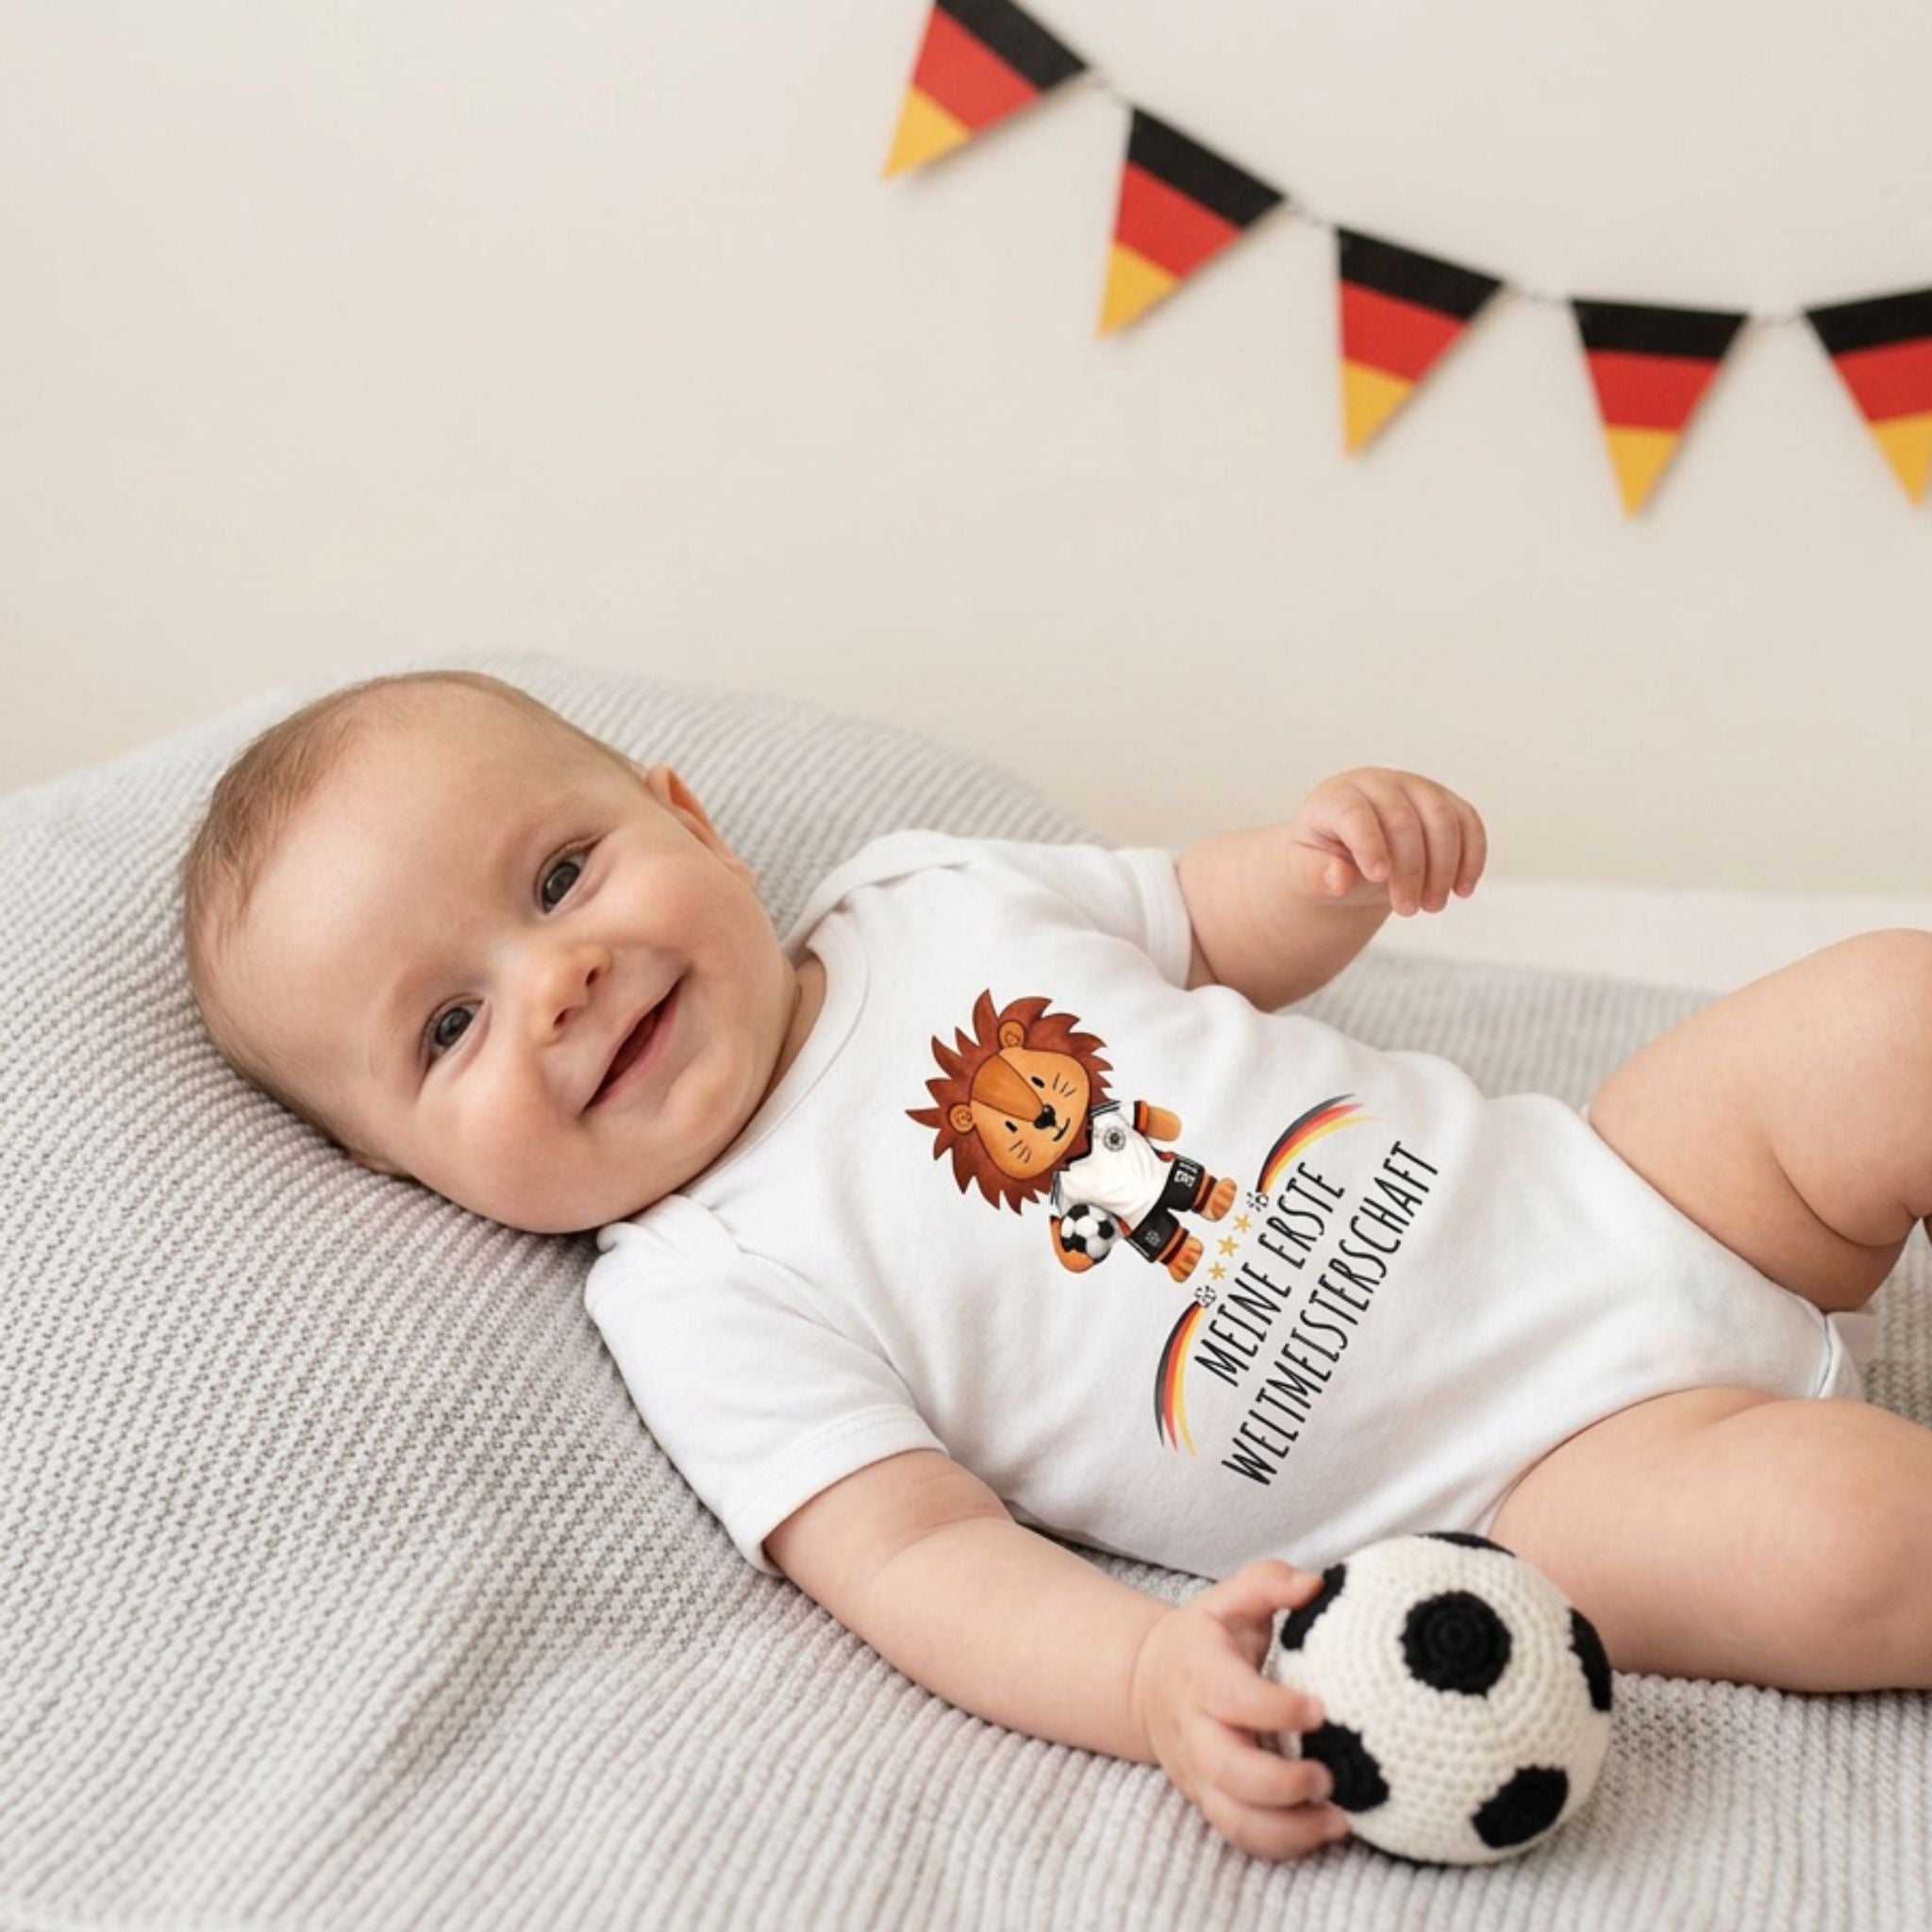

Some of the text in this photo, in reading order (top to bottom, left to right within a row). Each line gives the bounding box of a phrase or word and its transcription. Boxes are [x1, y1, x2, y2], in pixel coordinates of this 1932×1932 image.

[1193, 1161, 1345, 1388] MEINE ERSTE
[1221, 1141, 1439, 1486] WELTMEISTERSCHAFT
